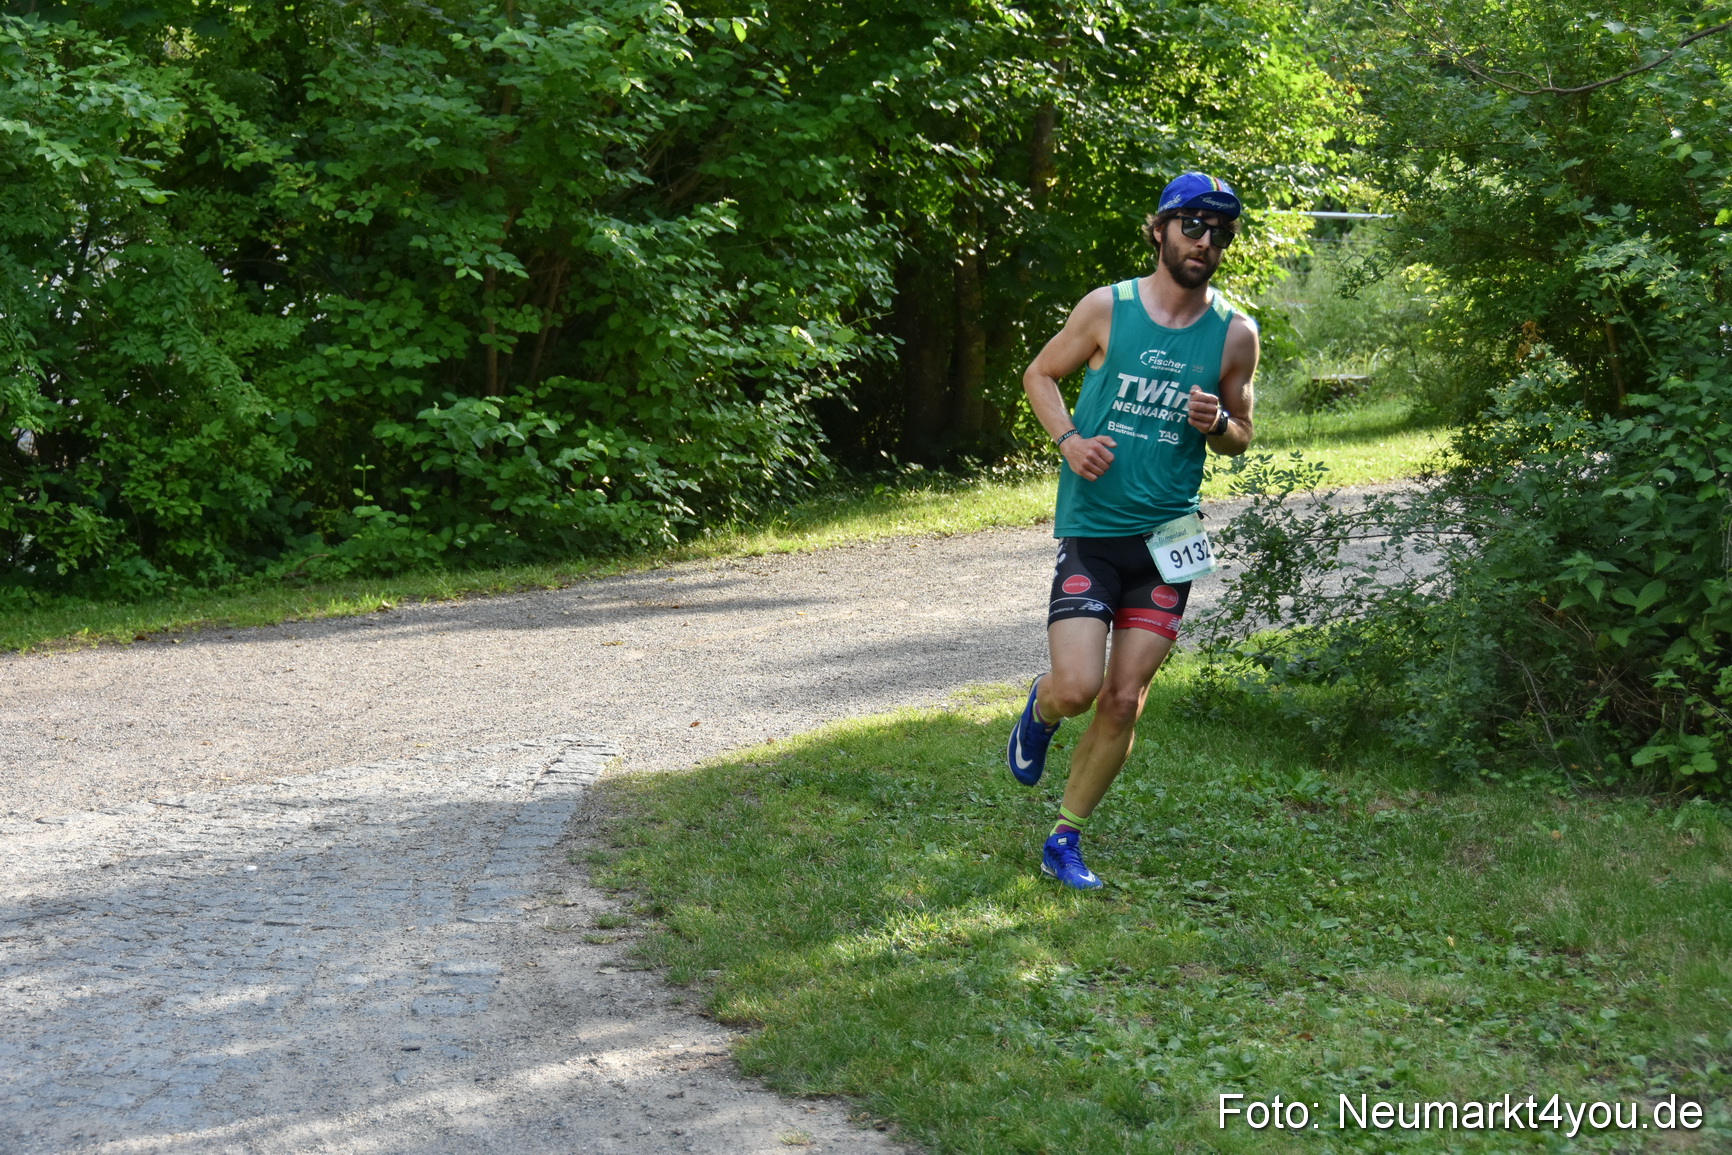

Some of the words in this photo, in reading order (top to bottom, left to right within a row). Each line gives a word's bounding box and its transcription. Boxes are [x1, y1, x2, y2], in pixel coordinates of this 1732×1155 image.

[1148, 355, 1186, 369] Fischer
[1117, 372, 1191, 412] TWin
[1112, 400, 1187, 423] NEUMARKT
[1159, 430, 1179, 441] TAO
[1169, 539, 1211, 569] 9132
